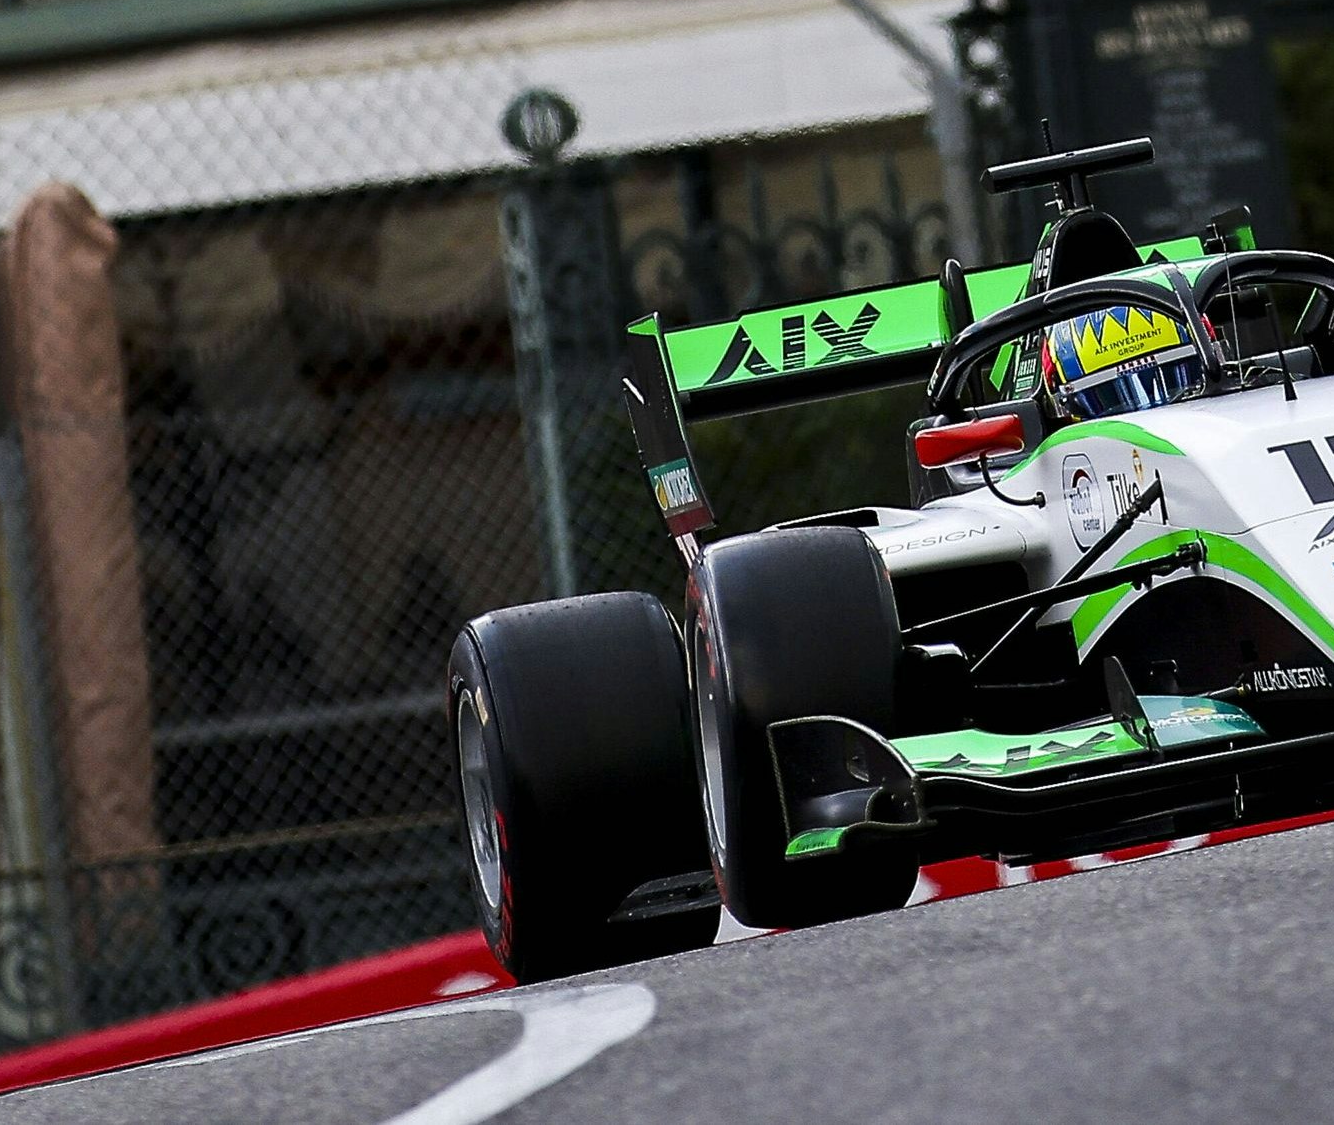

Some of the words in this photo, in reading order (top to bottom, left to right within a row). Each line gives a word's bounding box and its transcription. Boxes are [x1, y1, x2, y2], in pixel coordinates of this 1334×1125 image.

[703, 302, 882, 386] AIX
[1109, 328, 1162, 350] INVESTMENT
[1118, 343, 1145, 356] GROUP
